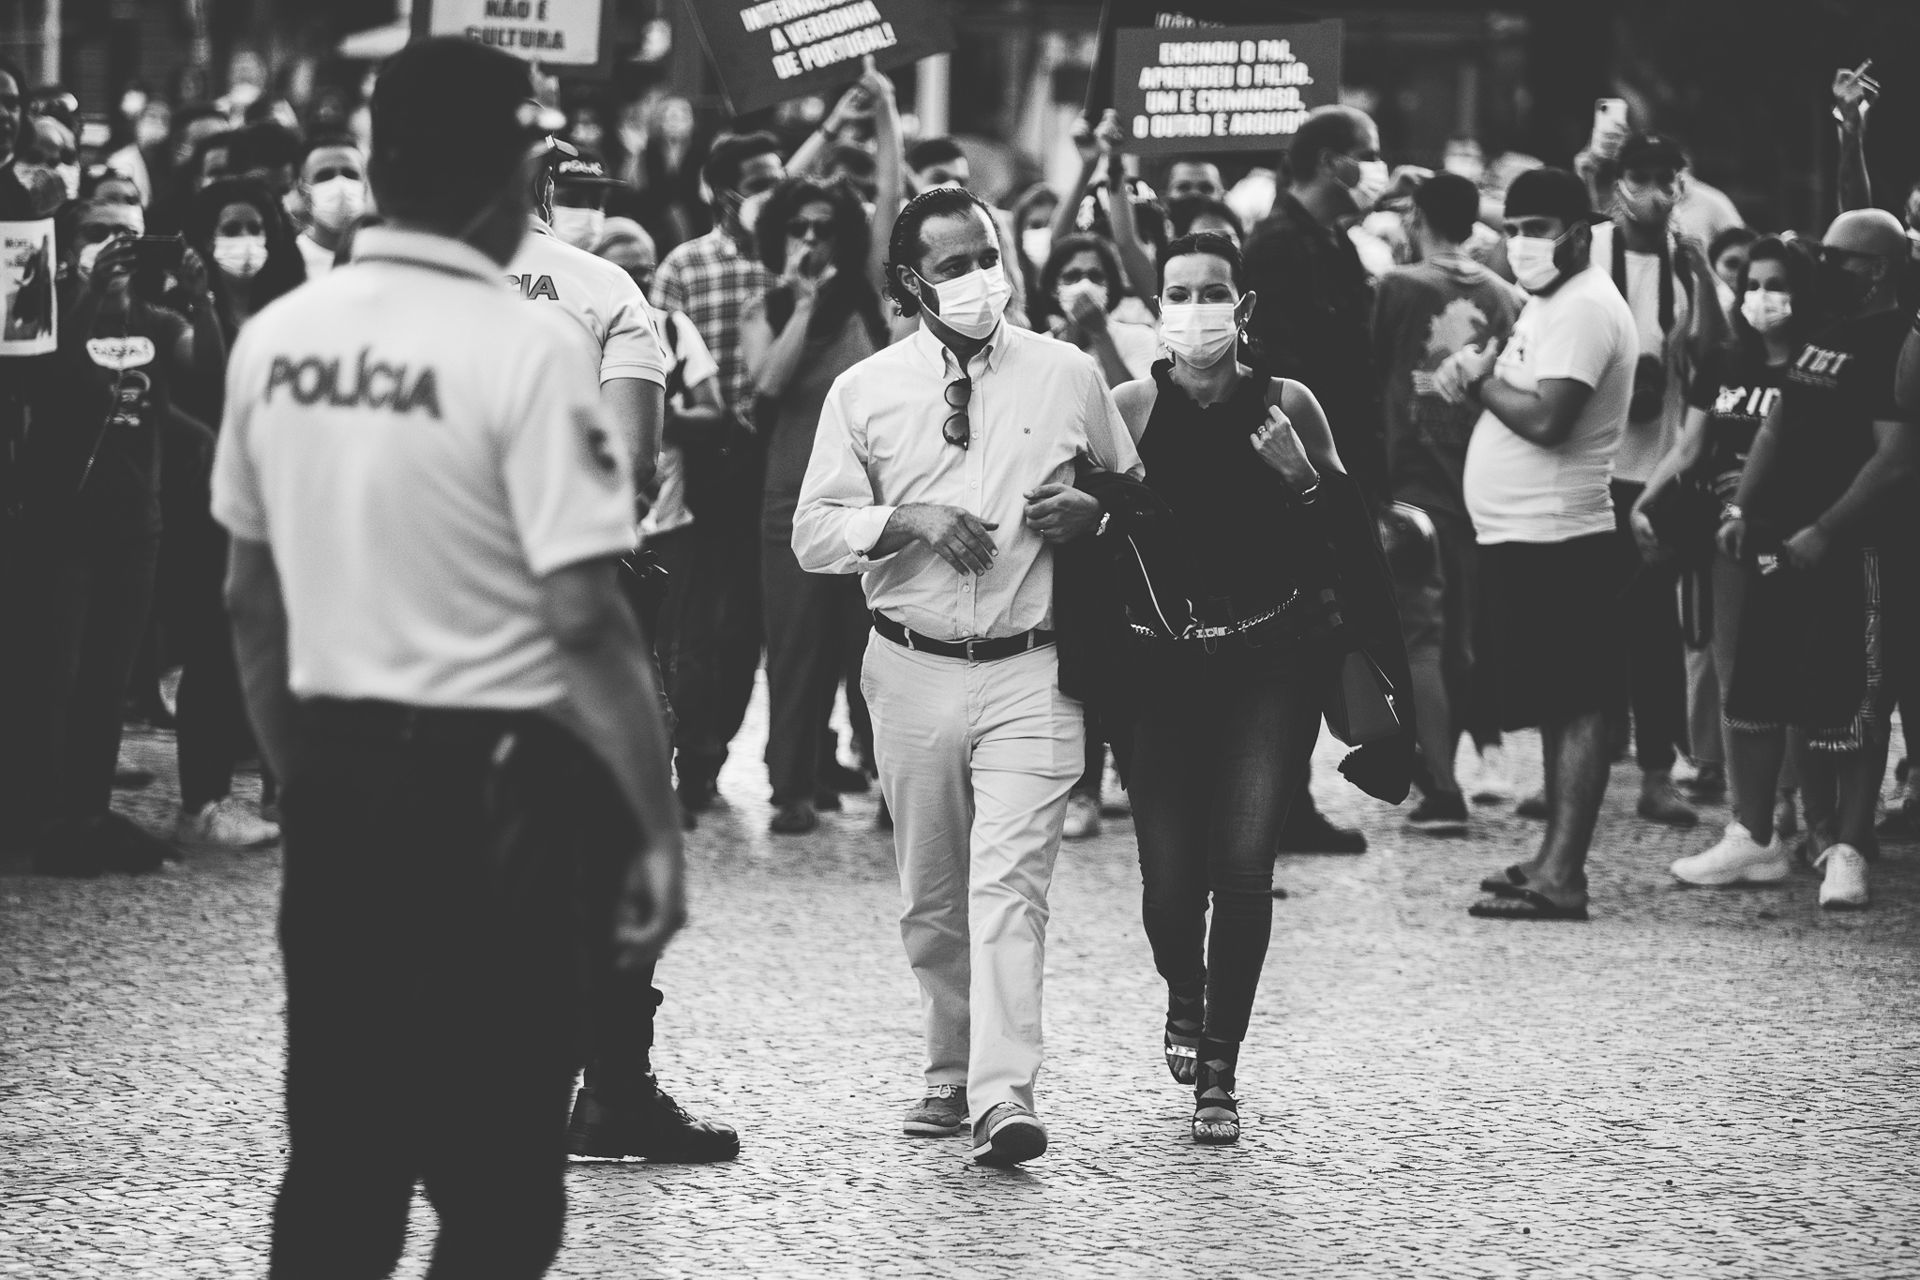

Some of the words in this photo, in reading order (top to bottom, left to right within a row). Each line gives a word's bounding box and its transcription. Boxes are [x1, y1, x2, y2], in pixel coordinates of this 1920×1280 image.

[1240, 40, 1256, 63] O
[773, 51, 803, 79] DE
[1236, 65, 1252, 87] O
[1146, 91, 1178, 113] UM
[1133, 115, 1149, 138] O
[264, 347, 442, 419] POLÍCIA
